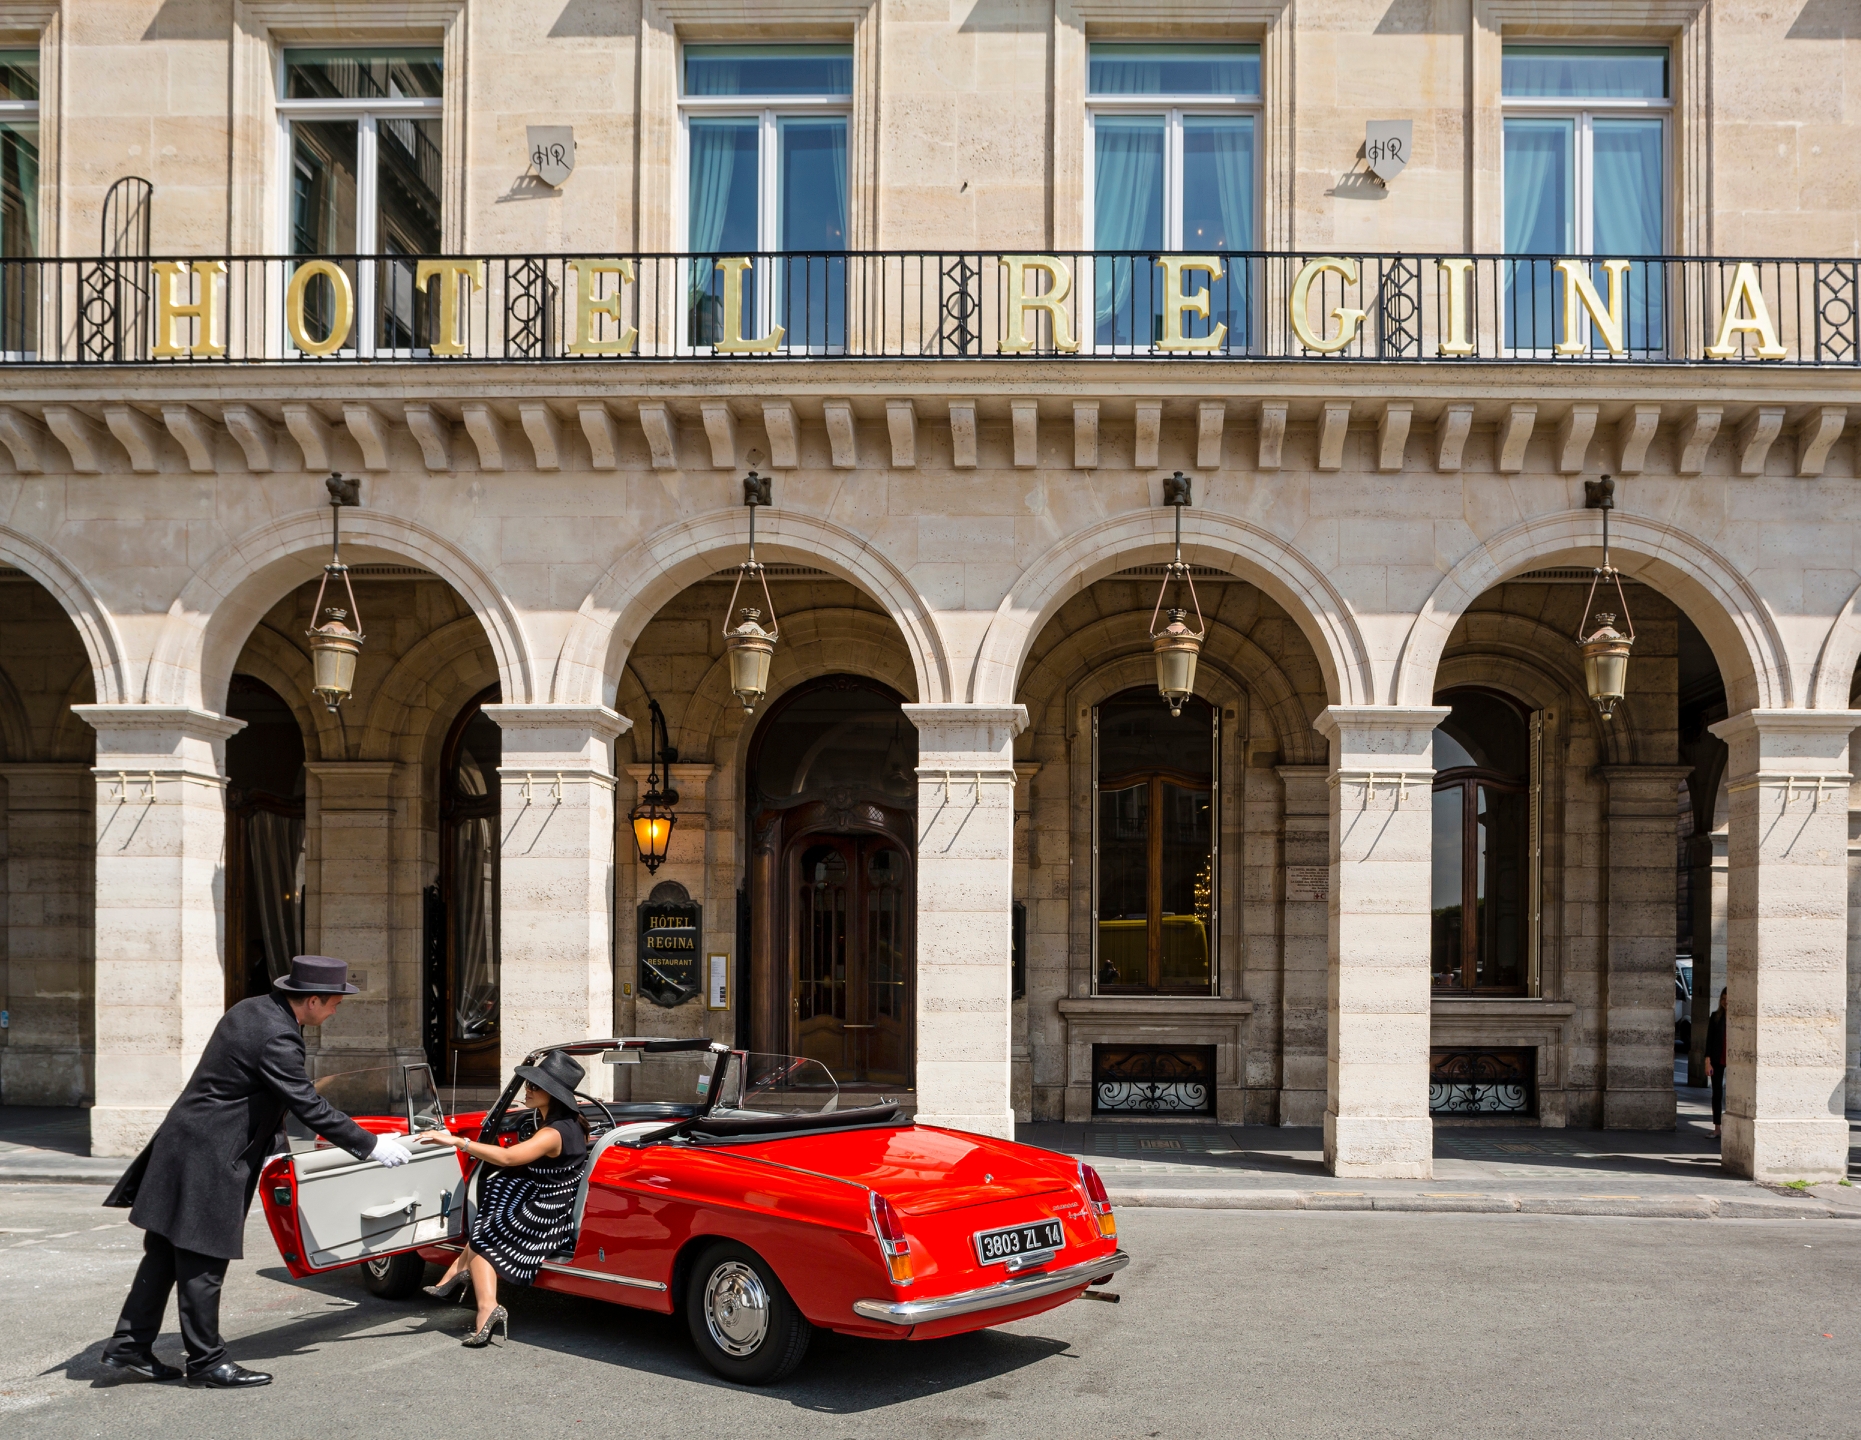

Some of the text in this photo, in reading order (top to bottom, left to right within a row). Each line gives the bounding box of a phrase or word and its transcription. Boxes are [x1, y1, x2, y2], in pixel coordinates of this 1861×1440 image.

[151, 255, 1788, 361] HOTEL REGINA
[649, 914, 693, 928] HÔTEL
[646, 936, 695, 949] REGINA
[647, 958, 693, 966] RESTAURANT
[984, 1224, 1061, 1257] 3803 ZL 14
